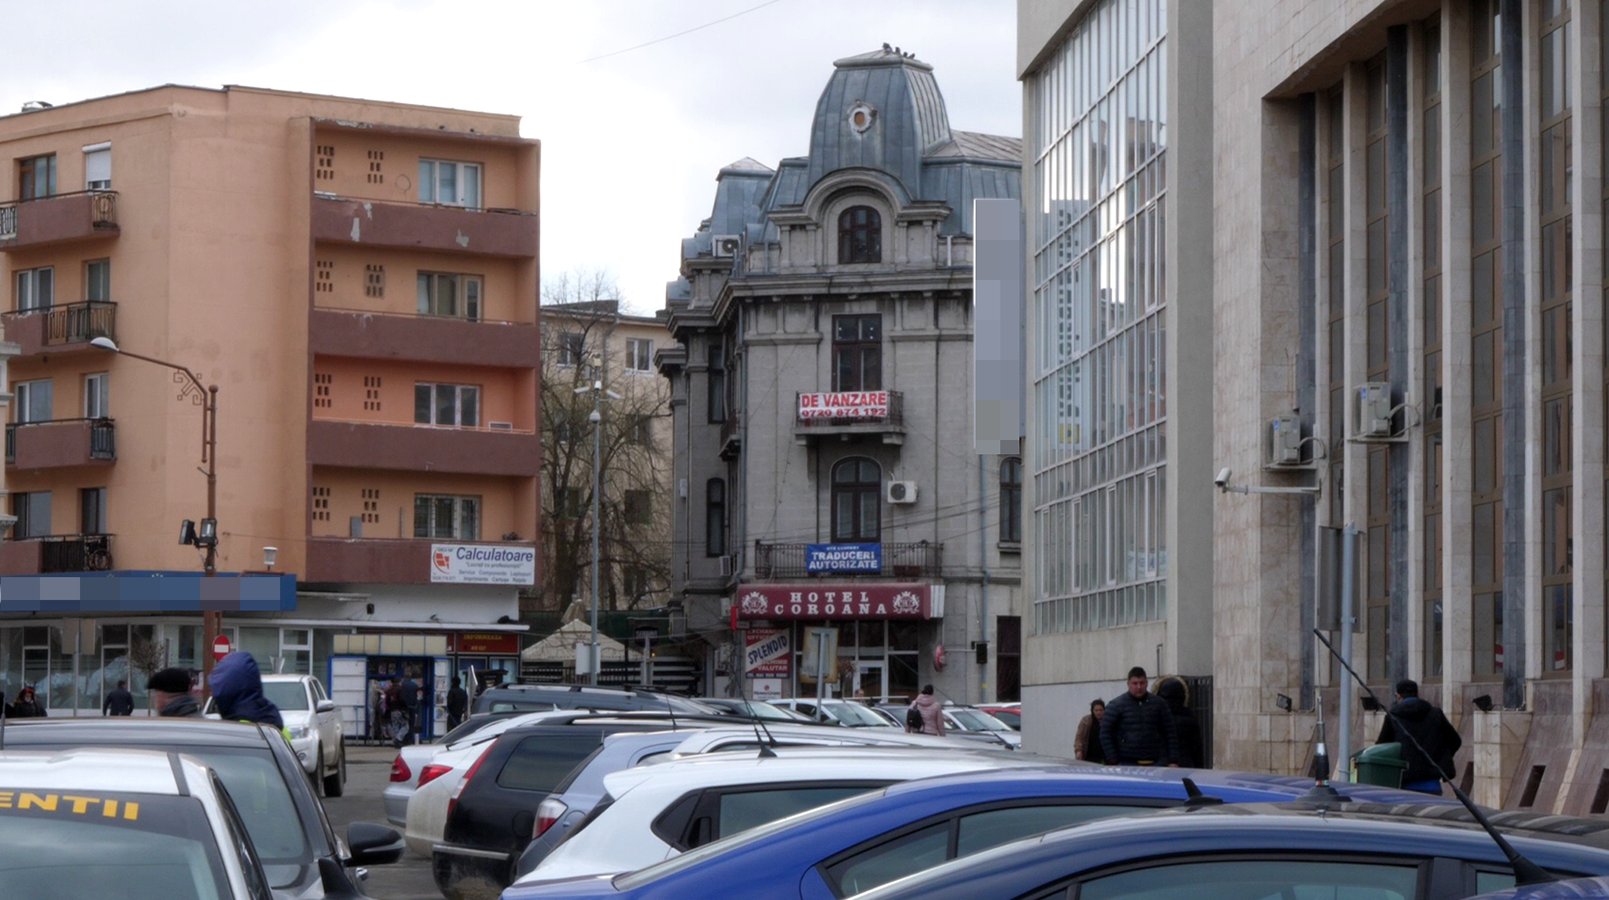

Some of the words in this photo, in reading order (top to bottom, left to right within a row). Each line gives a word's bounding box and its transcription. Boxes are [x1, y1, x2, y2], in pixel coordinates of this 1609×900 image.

[801, 394, 819, 408] DE
[823, 392, 887, 407] VANZARE
[801, 409, 833, 418] 0720
[836, 408, 860, 417] 874
[864, 407, 886, 416] 192
[456, 547, 533, 562] Calculatoare
[811, 550, 875, 561] TRADUCERI
[808, 559, 878, 570] AUTORIZATE
[790, 591, 869, 603] HOTEL
[774, 603, 888, 615] COROANA
[747, 634, 788, 665] SPLENDID
